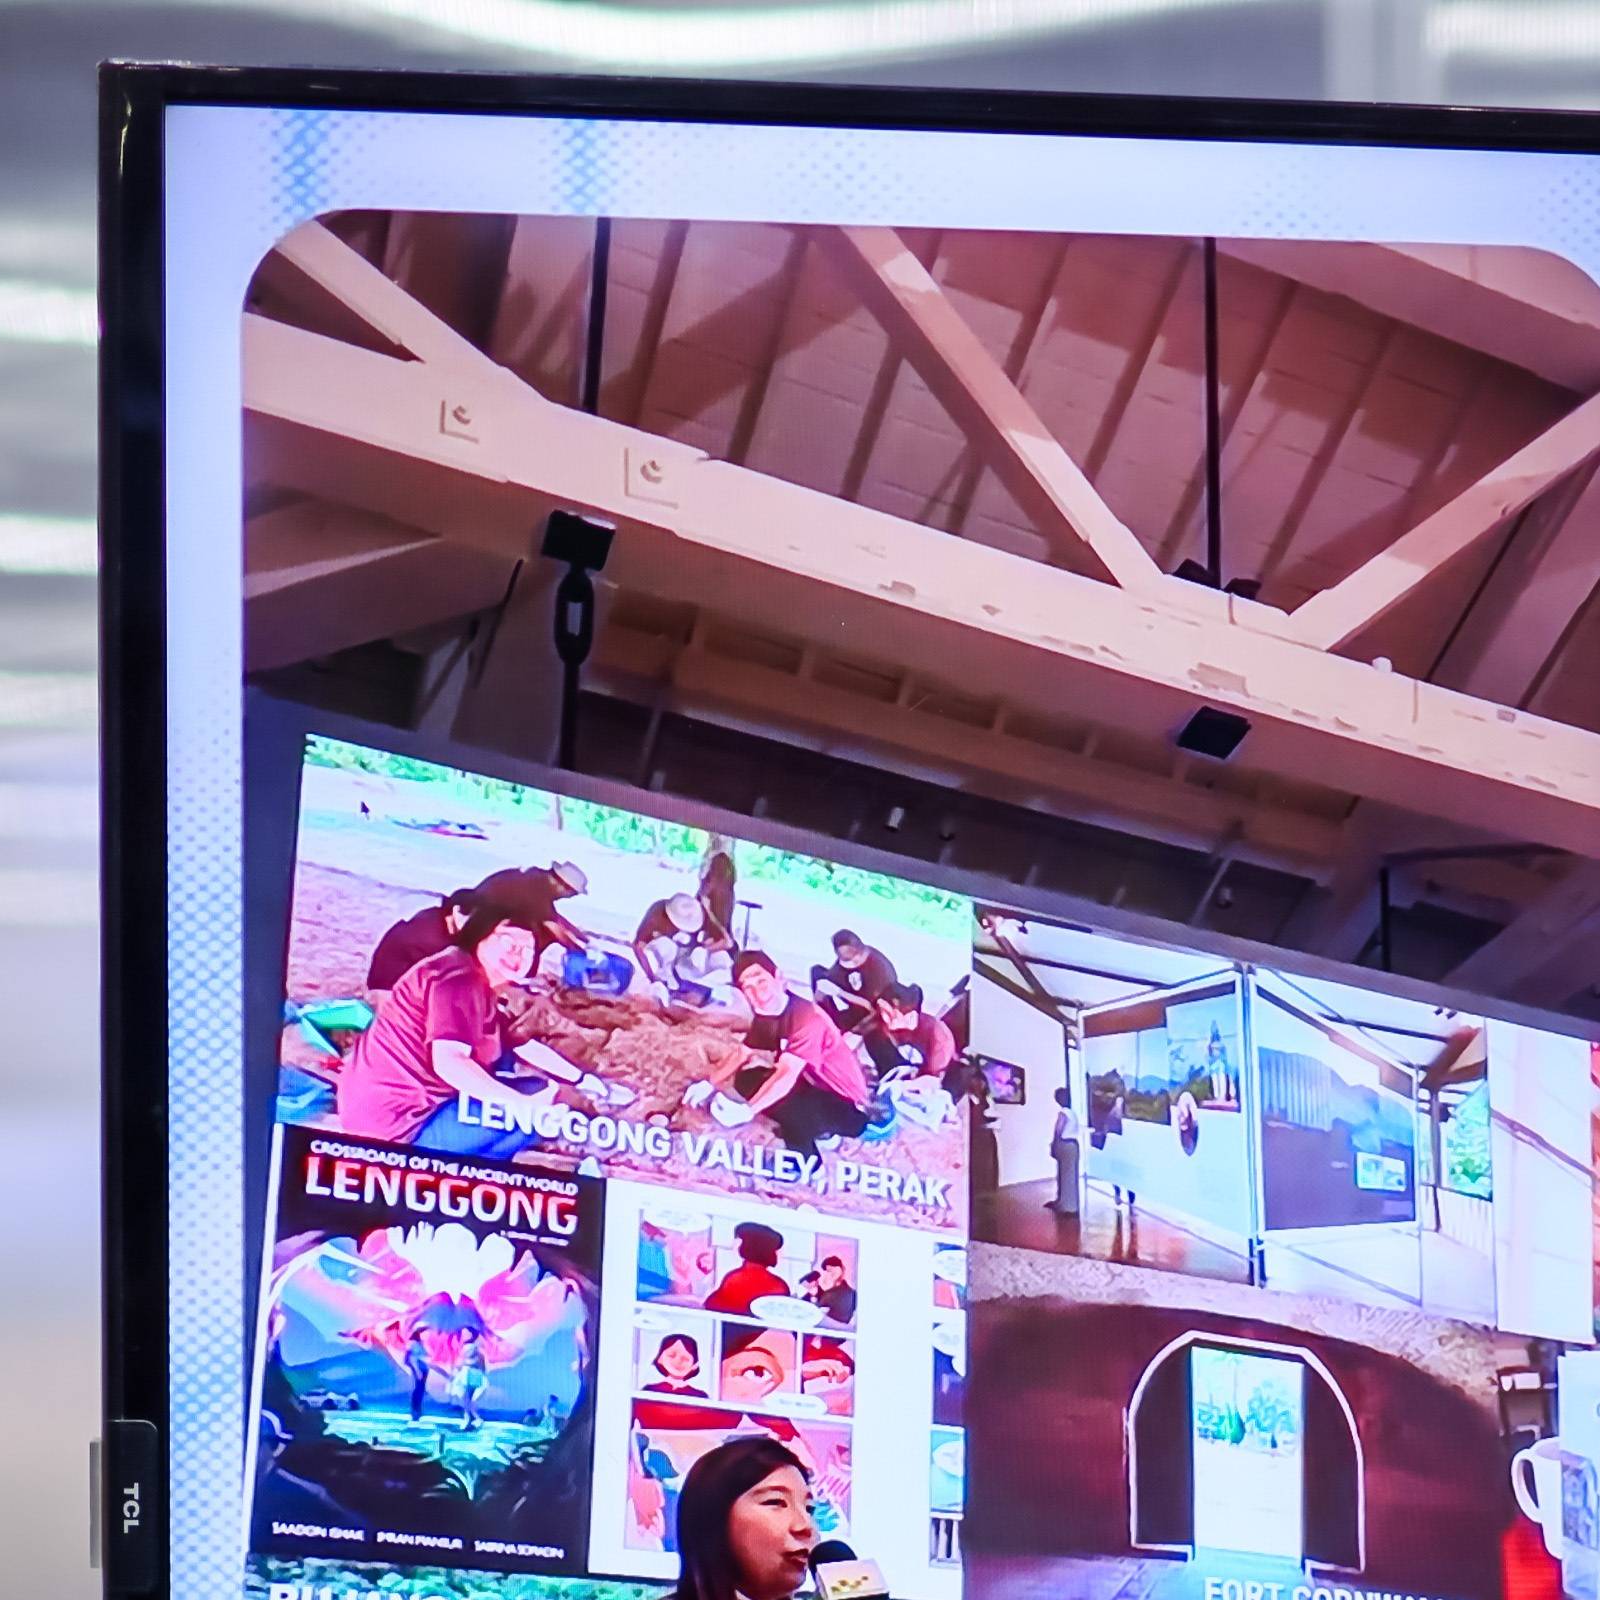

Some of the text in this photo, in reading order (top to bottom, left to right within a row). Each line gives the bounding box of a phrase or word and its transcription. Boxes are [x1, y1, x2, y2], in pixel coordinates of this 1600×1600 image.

[409, 1156, 429, 1172] OF
[523, 1175, 578, 1195] WORLD
[457, 1093, 951, 1205] LENGGONG VALLEY, PERAK
[305, 1156, 578, 1235] LENGGONG
[123, 1482, 140, 1534] TCL
